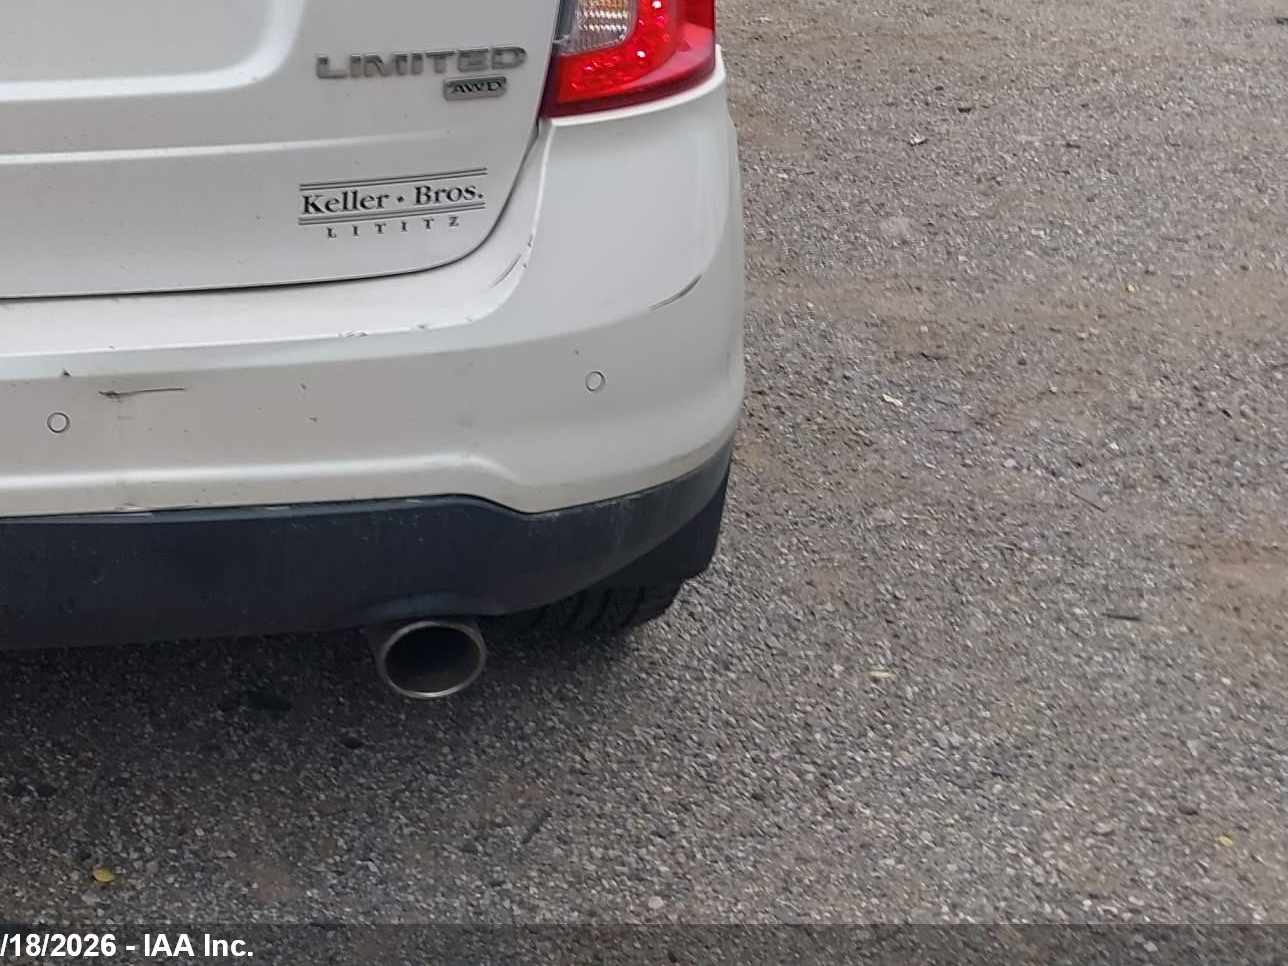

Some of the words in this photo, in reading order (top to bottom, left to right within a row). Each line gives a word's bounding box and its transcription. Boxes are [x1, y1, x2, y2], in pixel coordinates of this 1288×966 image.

[316, 46, 527, 79] LIMITED
[450, 81, 505, 94] AWD
[302, 190, 389, 215] Keller
[414, 185, 483, 205] Bros.
[326, 216, 459, 238] LITITZ
